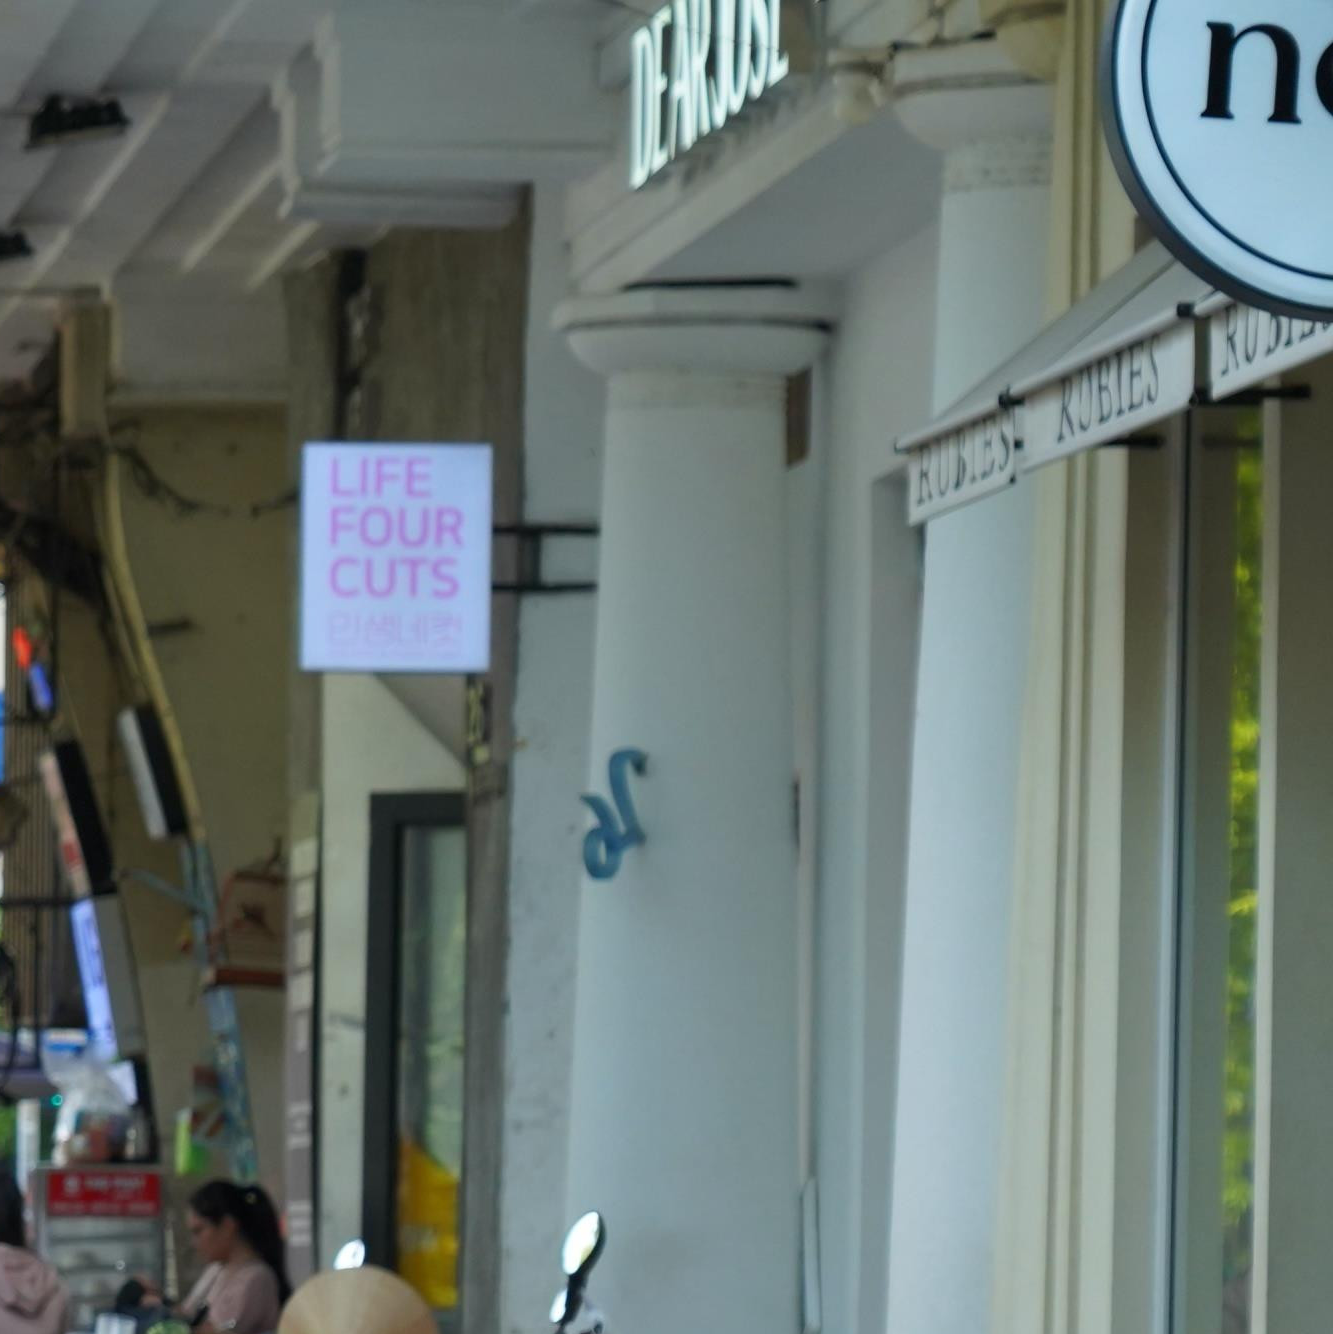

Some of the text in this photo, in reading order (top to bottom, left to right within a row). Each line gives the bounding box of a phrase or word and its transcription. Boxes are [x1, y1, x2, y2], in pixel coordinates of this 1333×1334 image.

[1200, 20, 1333, 125] n
[1057, 336, 1161, 443] RUBIES
[328, 455, 434, 499] LIFE
[917, 415, 1012, 506] RUBIES
[328, 505, 465, 549] FOUR
[328, 556, 461, 600] CUTS
